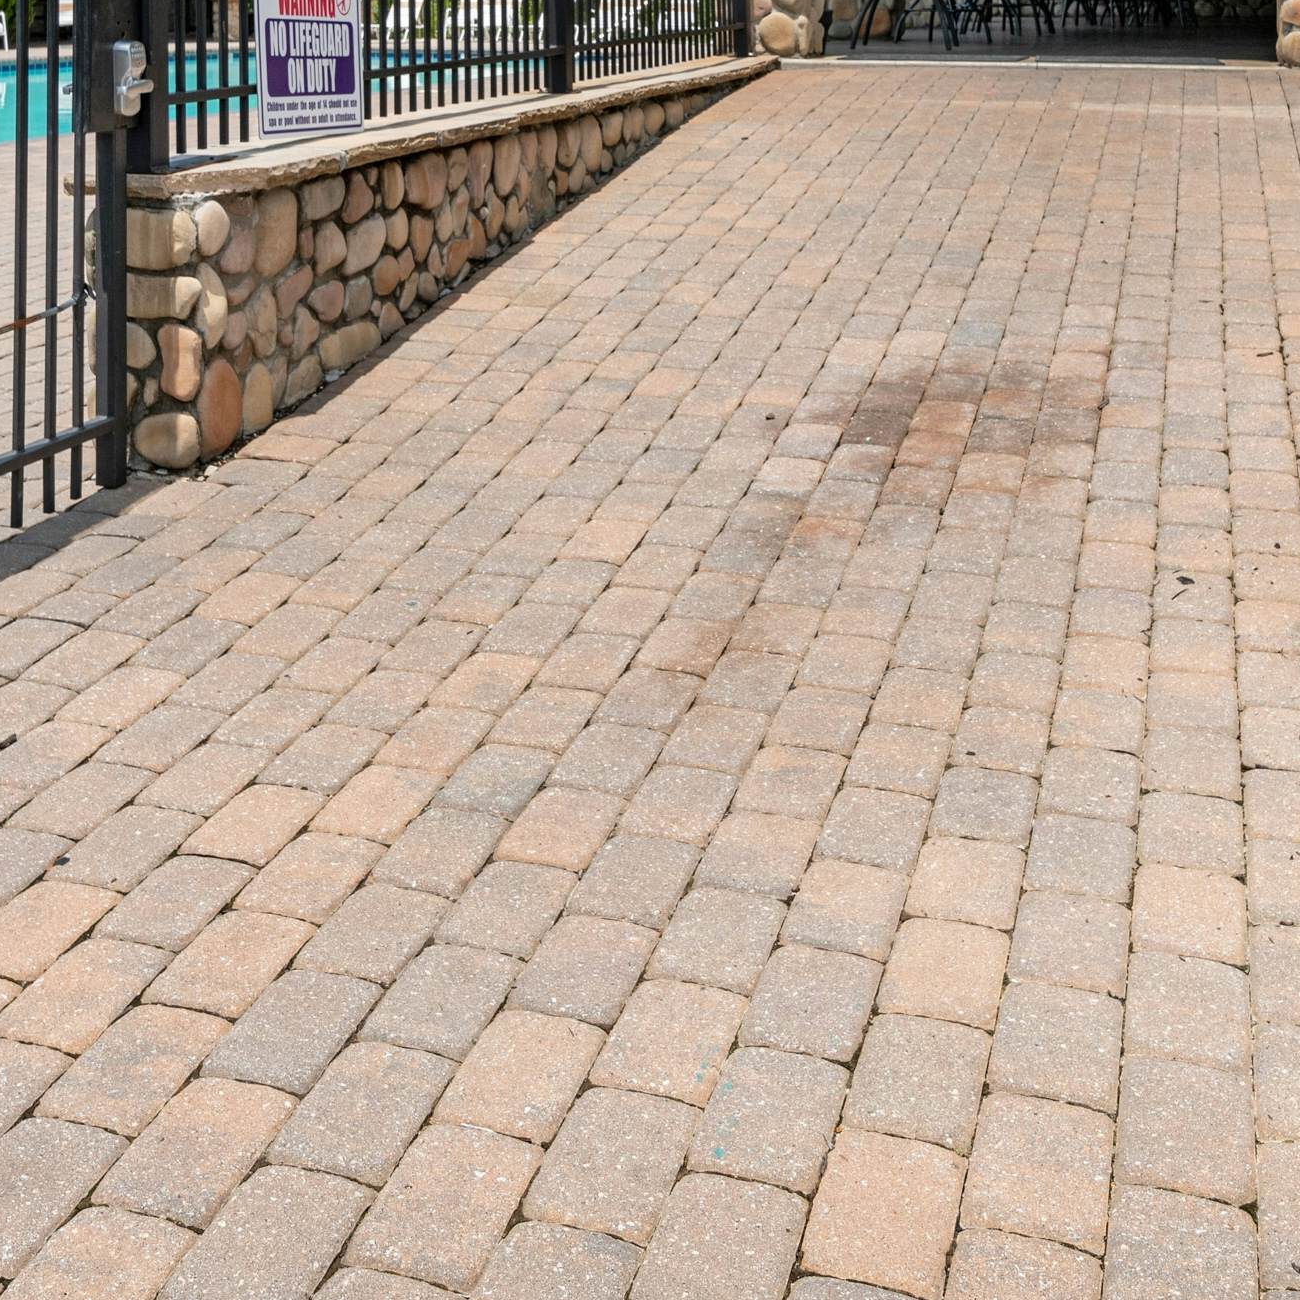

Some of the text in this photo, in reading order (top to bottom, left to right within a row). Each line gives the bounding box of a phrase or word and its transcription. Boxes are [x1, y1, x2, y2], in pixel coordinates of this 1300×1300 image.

[269, 20, 350, 57] NO LIFEGUARD
[287, 57, 336, 94] ON DUTY
[267, 101, 285, 112] Children
[286, 101, 298, 111] under
[308, 101, 316, 111] age
[317, 100, 322, 109] of
[322, 100, 327, 108] 14
[328, 99, 341, 108] should
[278, 118, 283, 126] or
[284, 116, 293, 127] pool
[295, 114, 310, 124] without
[312, 116, 317, 124] an
[318, 114, 328, 123] adult
[330, 114, 334, 122] in
